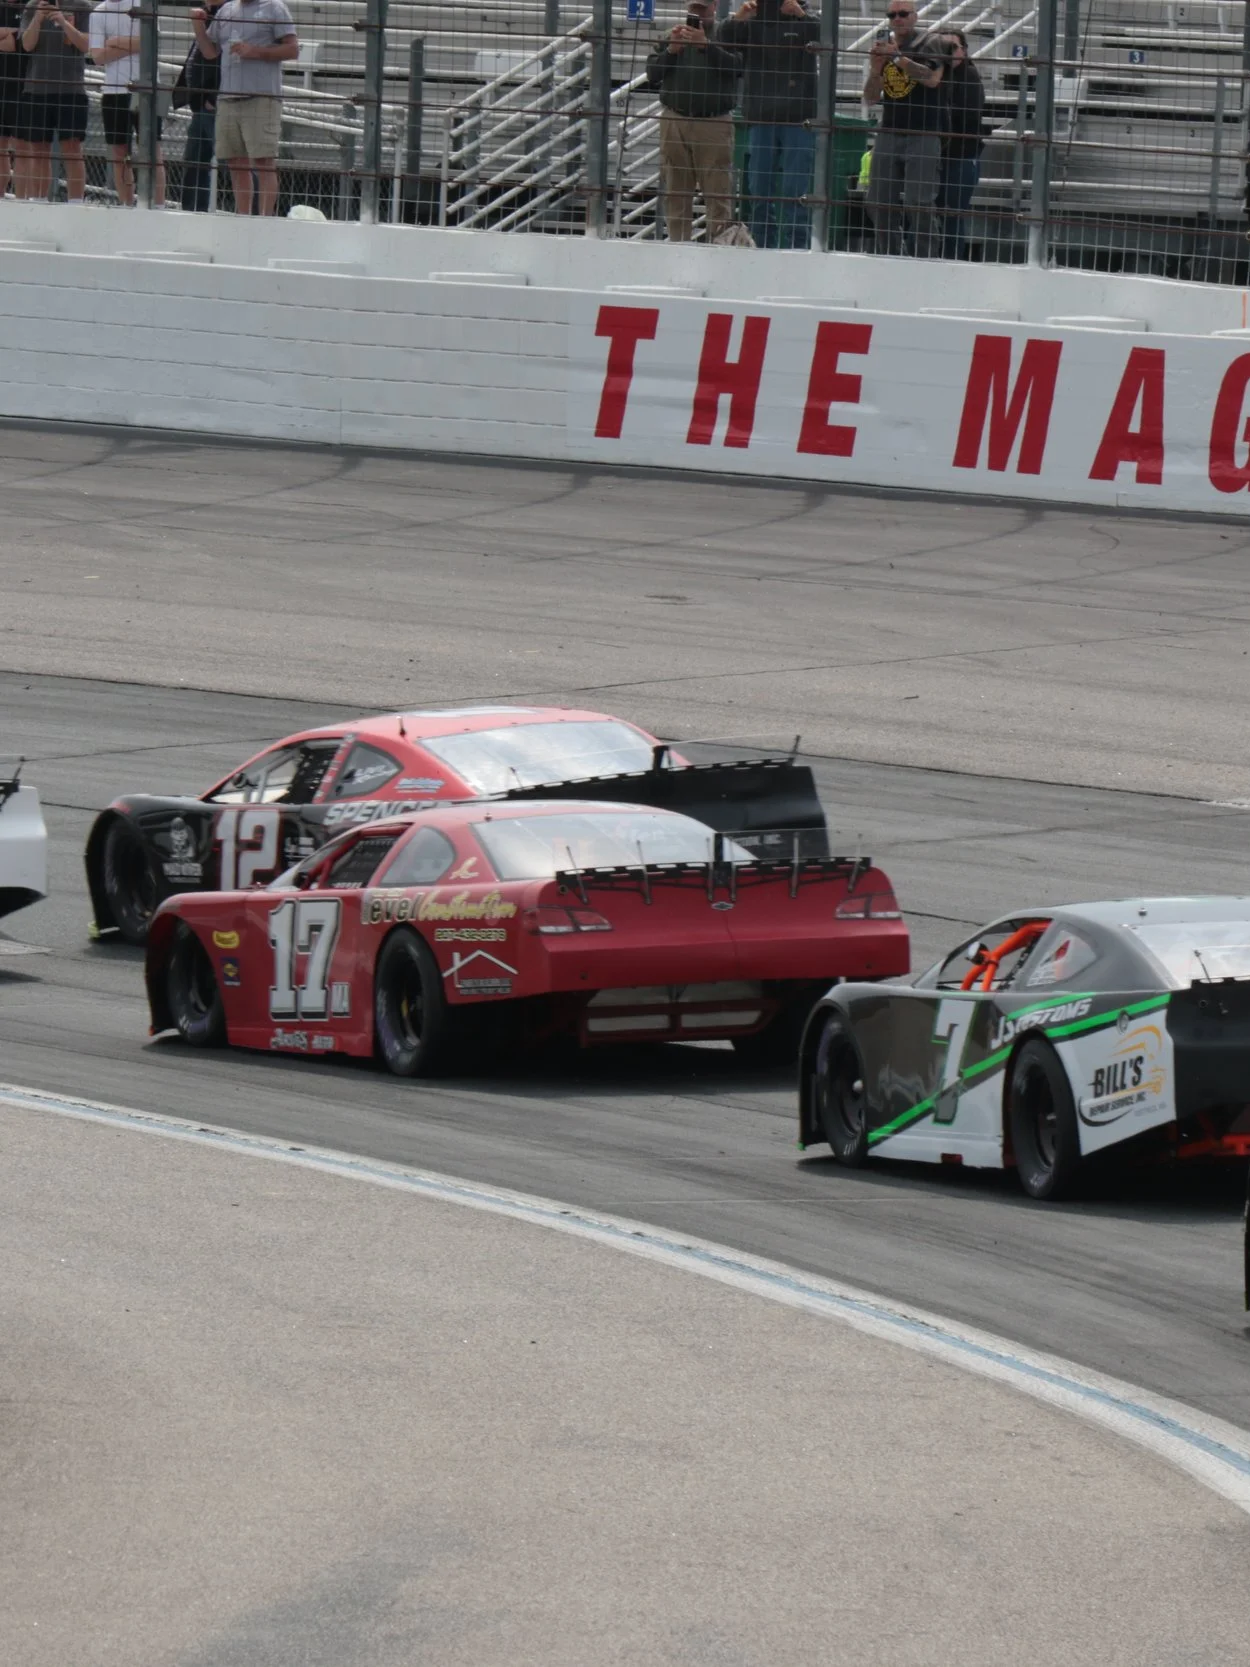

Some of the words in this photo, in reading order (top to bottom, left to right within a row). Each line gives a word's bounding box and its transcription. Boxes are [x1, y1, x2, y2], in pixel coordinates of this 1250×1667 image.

[594, 305, 873, 457] THE
[214, 807, 281, 891] 12
[268, 898, 343, 1022] 17
[931, 998, 977, 1124] 7
[1090, 1055, 1144, 1099] BILL'S
